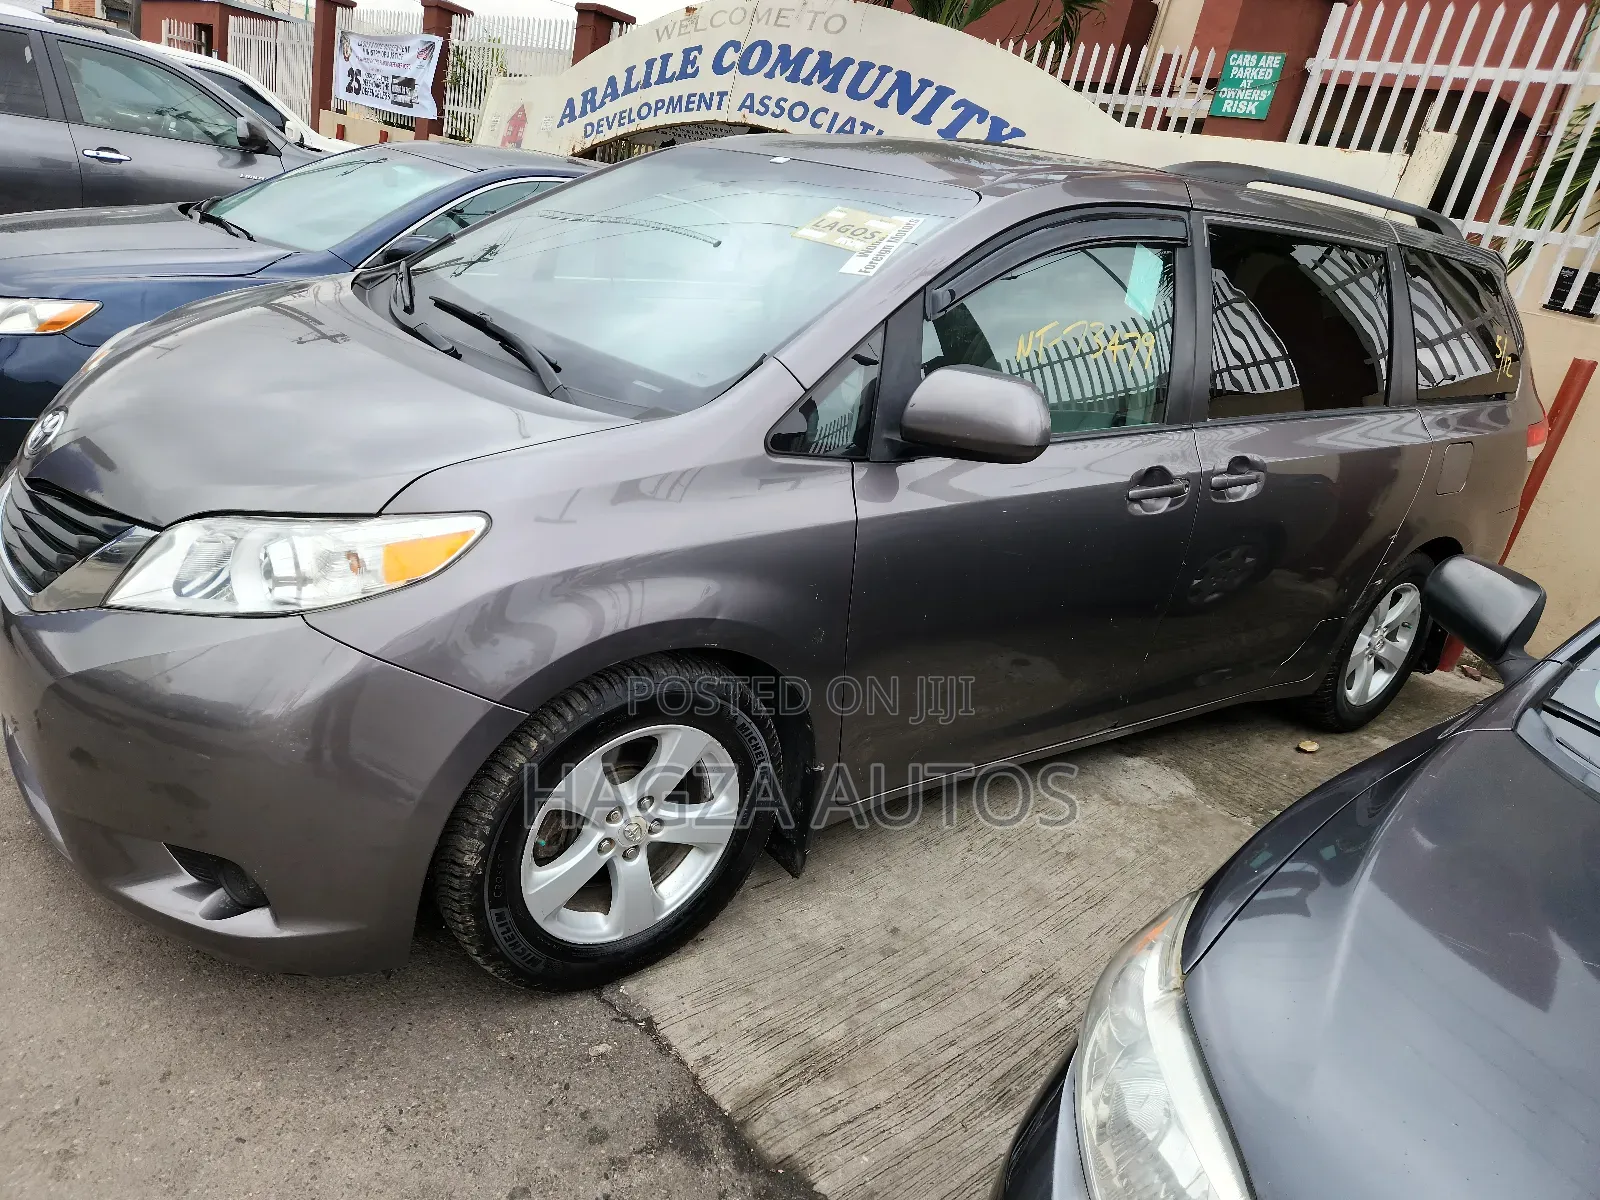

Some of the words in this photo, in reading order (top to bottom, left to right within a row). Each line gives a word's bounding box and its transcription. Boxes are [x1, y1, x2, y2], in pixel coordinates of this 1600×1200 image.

[655, 6, 796, 43] WELCOME
[806, 10, 847, 35] TO
[1229, 53, 1257, 67] CARS
[1258, 55, 1281, 68] ARE
[345, 66, 361, 96] 25
[1230, 66, 1273, 80] PARKED
[1239, 79, 1253, 88] AT
[556, 44, 703, 129] ARALILE
[711, 39, 1027, 144] COMMUNITY
[1219, 87, 1271, 101] OWNERS'
[583, 90, 729, 139] DEVELOPMENT
[737, 92, 885, 136] ASSOCIAT
[1222, 99, 1259, 114] RISK
[811, 218, 881, 240] LAGOS
[858, 243, 895, 274] Foreign
